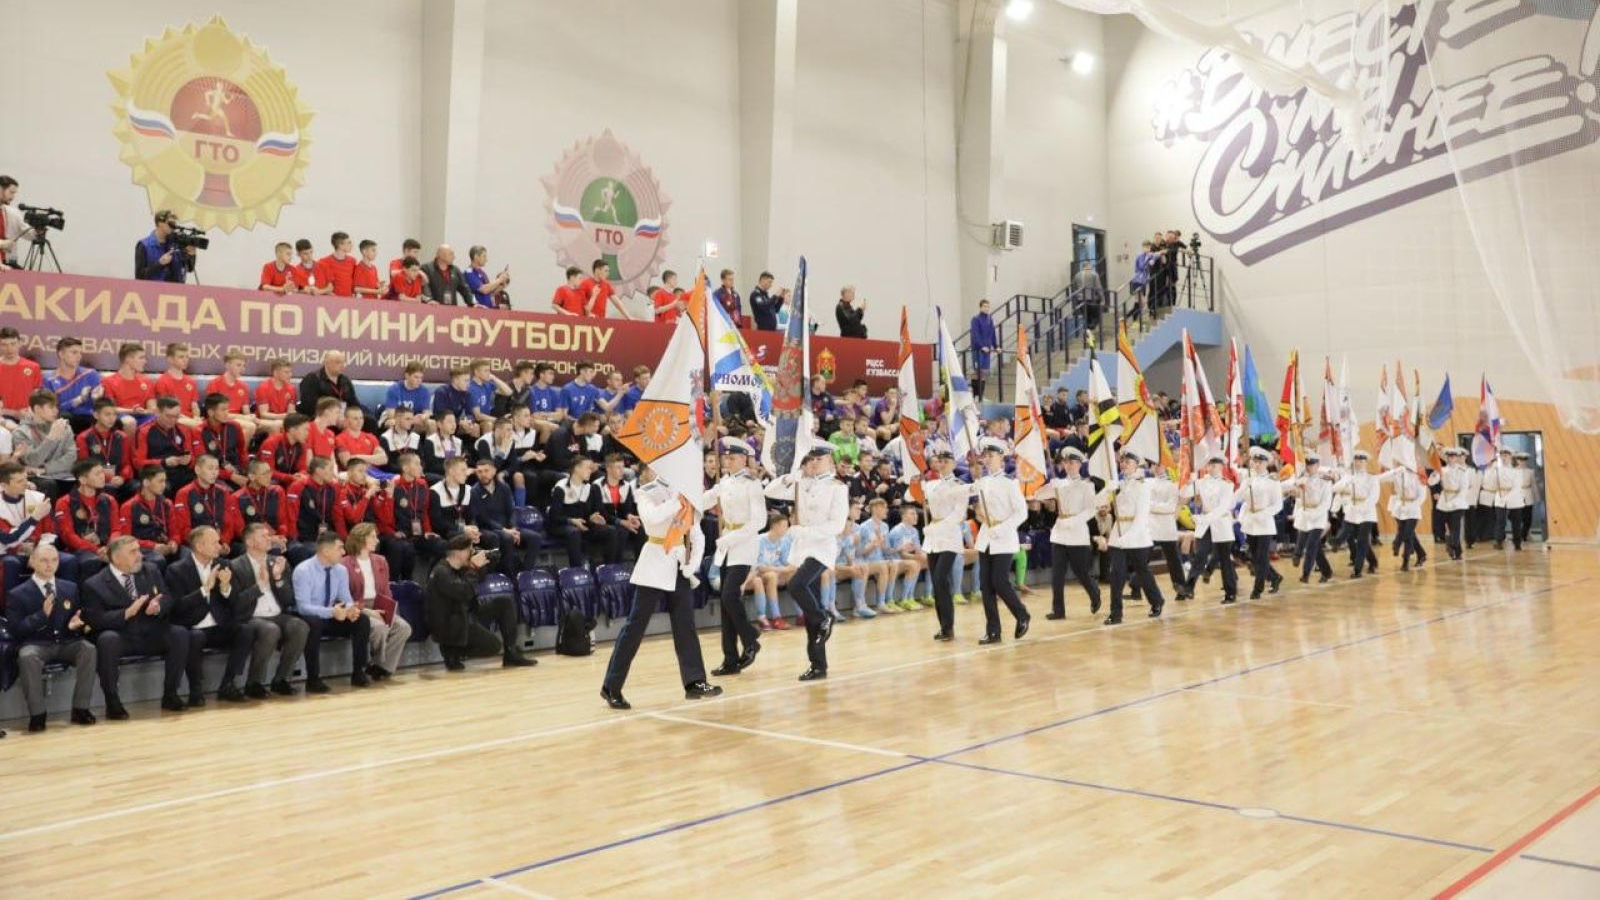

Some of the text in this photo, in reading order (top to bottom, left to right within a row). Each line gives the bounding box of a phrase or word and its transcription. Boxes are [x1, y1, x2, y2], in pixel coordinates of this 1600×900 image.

[193, 140, 240, 163] ГТО
[595, 228, 624, 246] ГТО
[0, 283, 615, 354] АКИАДА ПО МИНИ-ФУТБОЛУ
[227, 344, 372, 368] ОРГАНИЗИЙ
[377, 352, 513, 371] МИНИСТЕРВА
